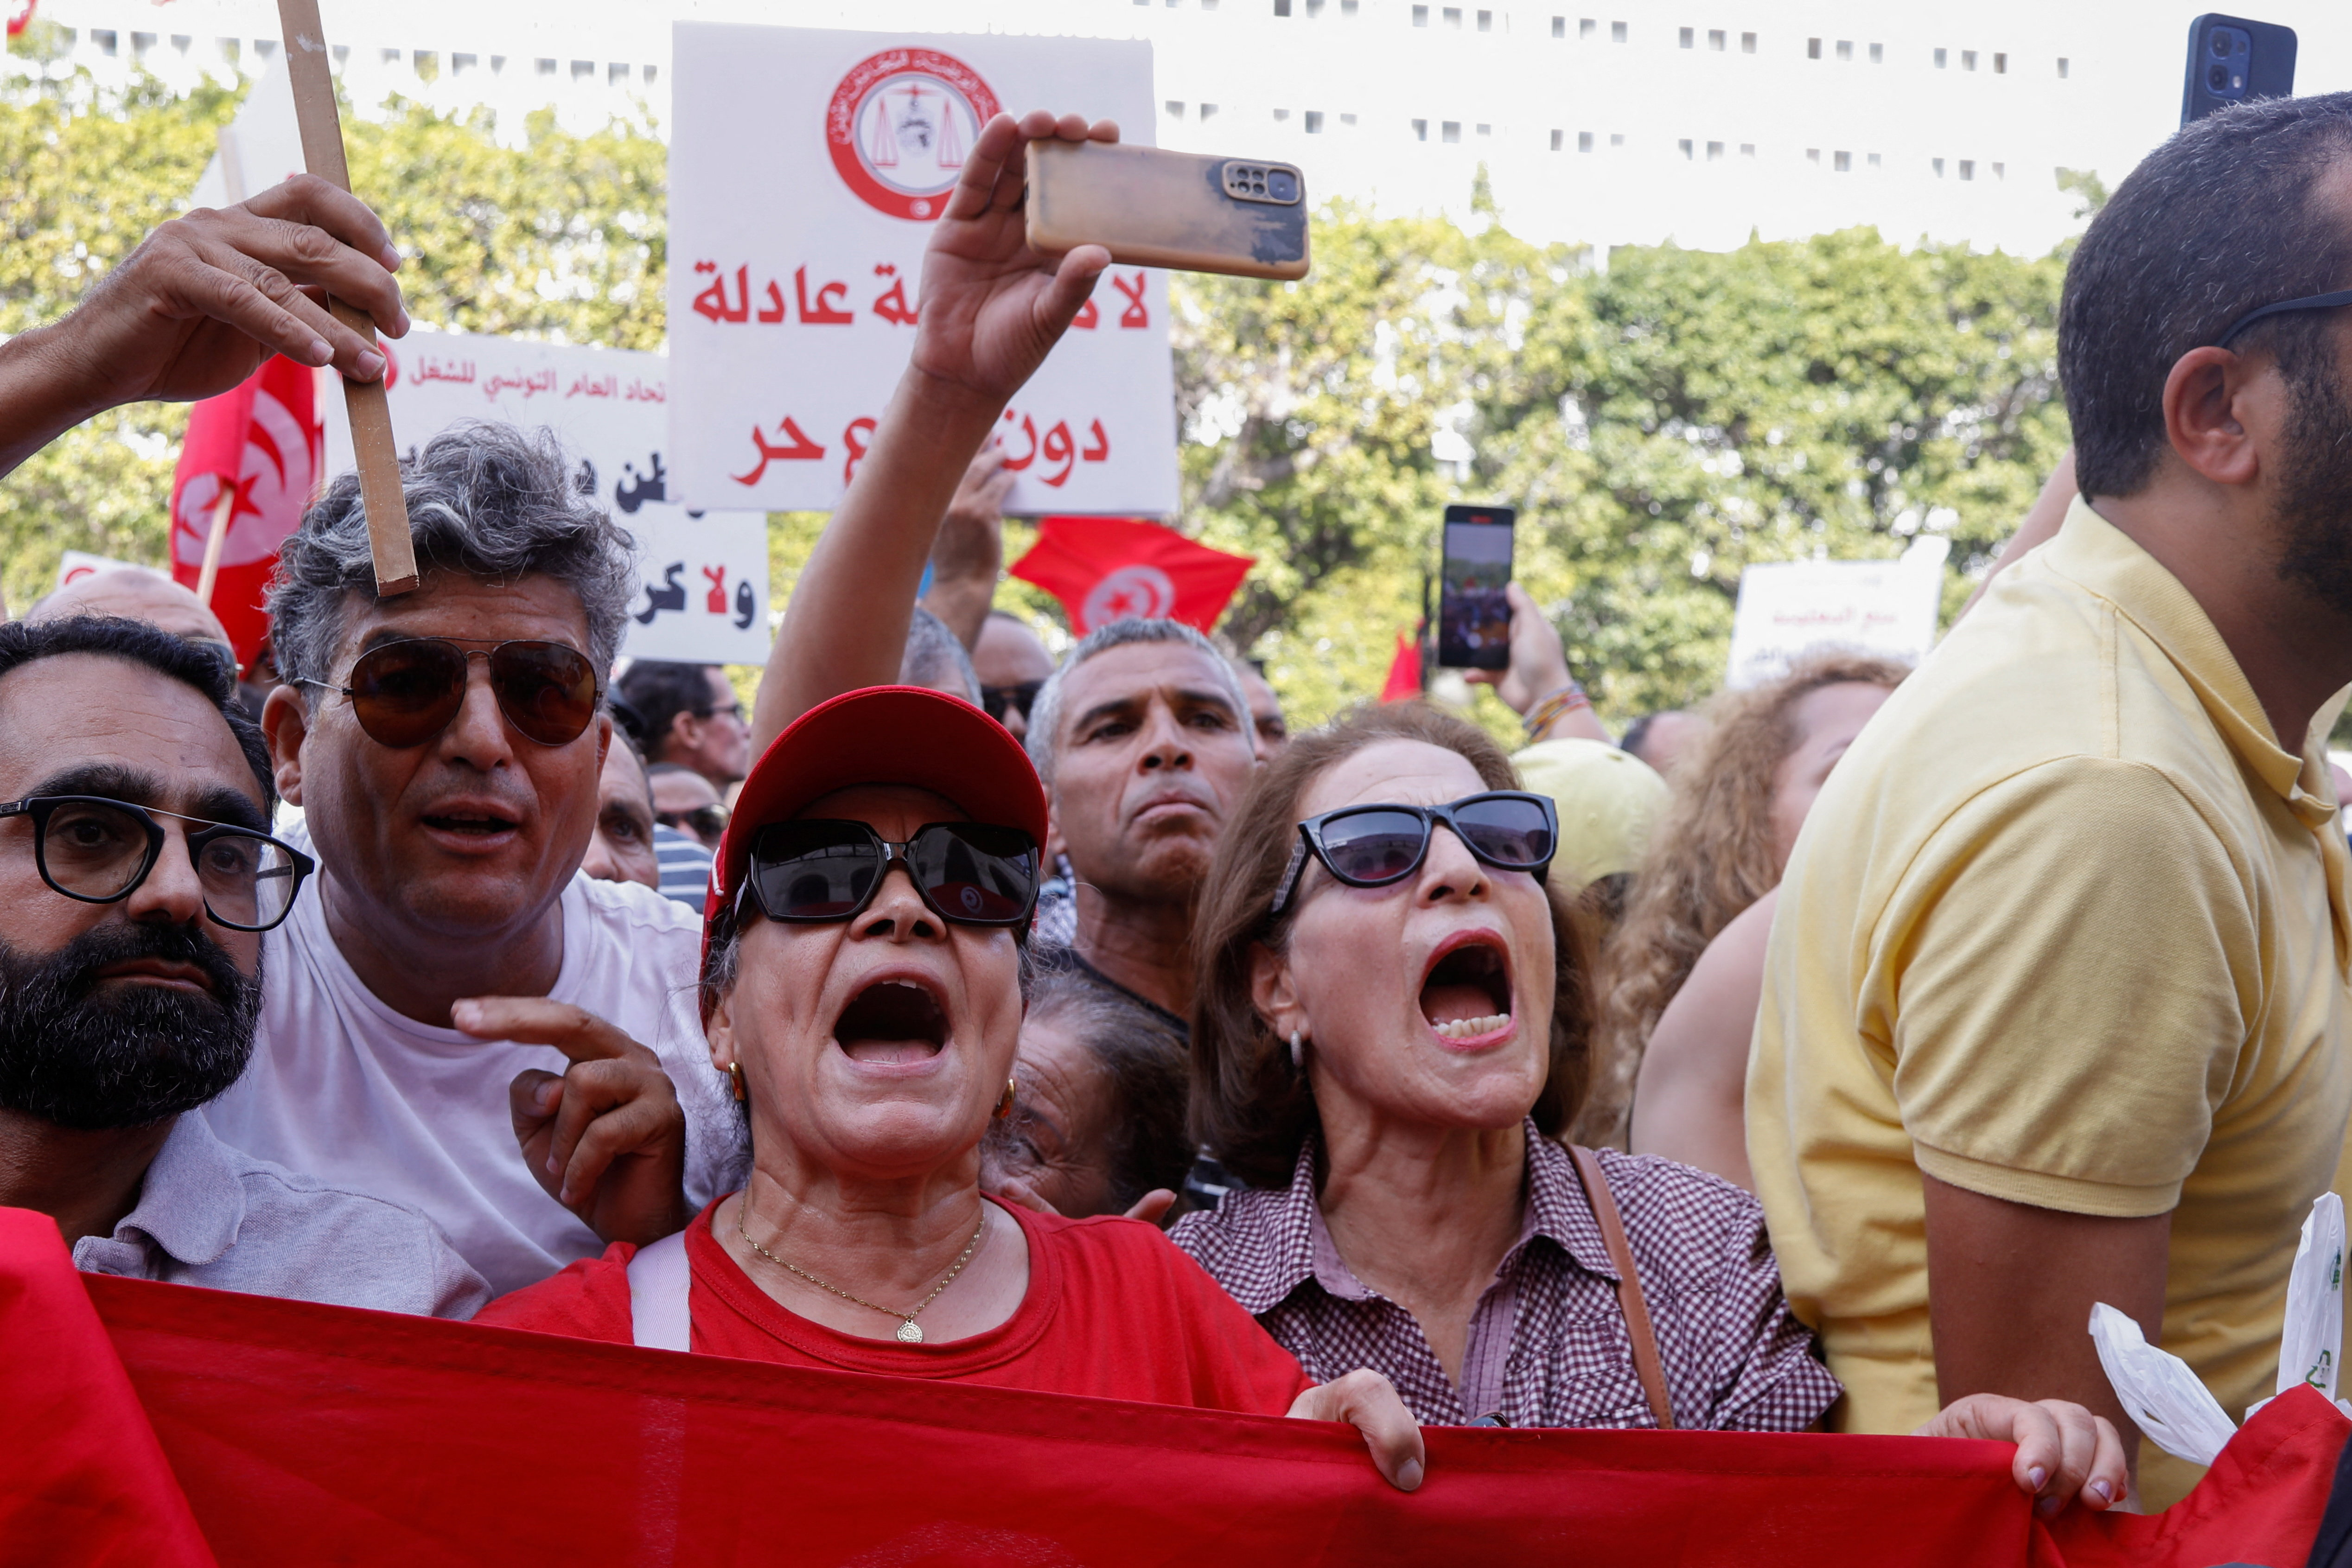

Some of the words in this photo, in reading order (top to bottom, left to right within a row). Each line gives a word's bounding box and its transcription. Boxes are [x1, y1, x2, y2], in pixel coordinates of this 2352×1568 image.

[693, 261, 853, 325] عادلة
[1113, 271, 1148, 328] لا
[409, 356, 476, 386] للشغل
[482, 367, 556, 402] التونسي
[566, 373, 618, 399] العام
[729, 414, 826, 487] حر
[996, 408, 1109, 487] دون
